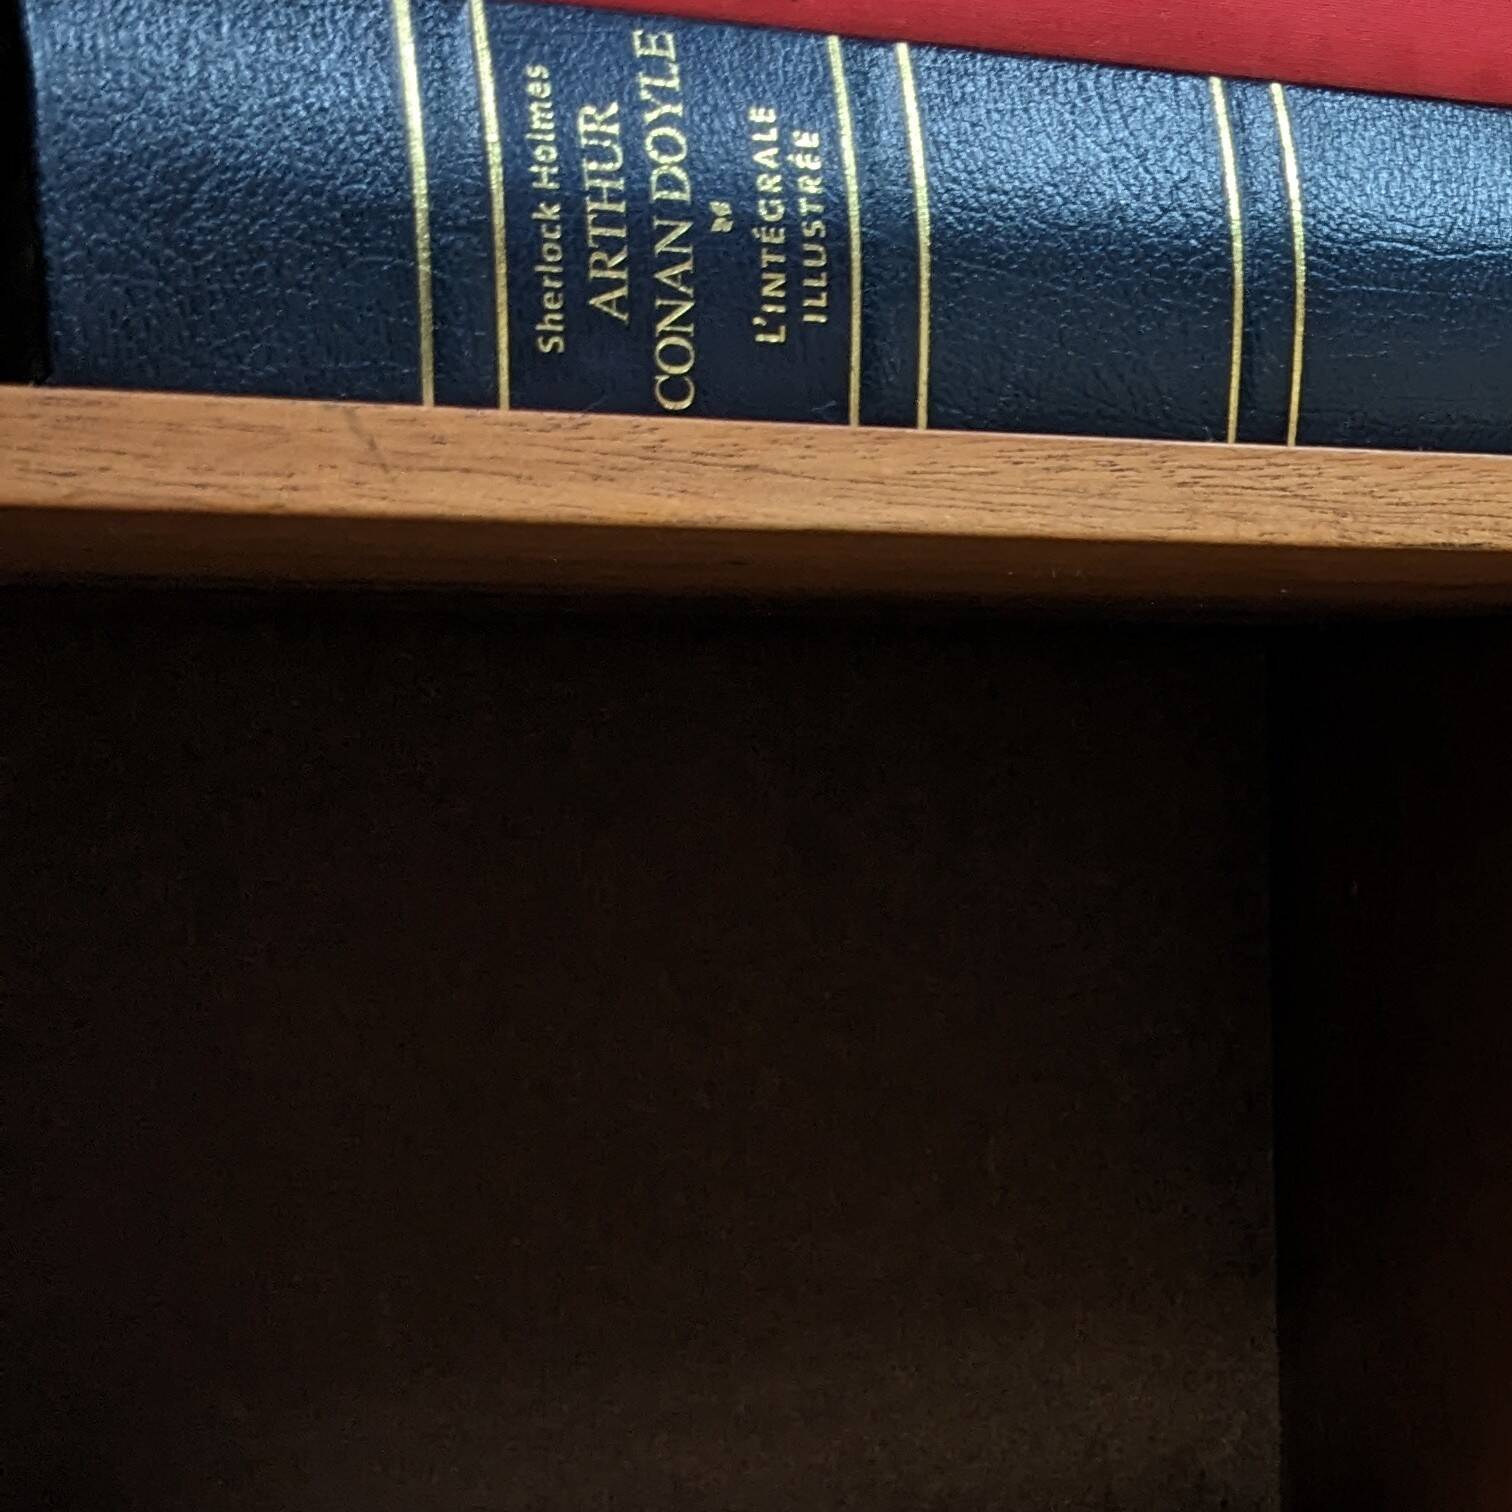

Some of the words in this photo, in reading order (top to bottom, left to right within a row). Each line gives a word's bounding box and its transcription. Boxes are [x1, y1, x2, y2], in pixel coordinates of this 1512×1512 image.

[525, 64, 561, 190] Holmes
[577, 101, 629, 324] ARTHUR
[633, 29, 692, 205] DOYLE
[532, 201, 565, 354] Sherlock
[654, 216, 695, 411] CONAN
[748, 105, 787, 344] L'INTÉGRALE
[788, 129, 828, 323] ILLUSTRÉE
